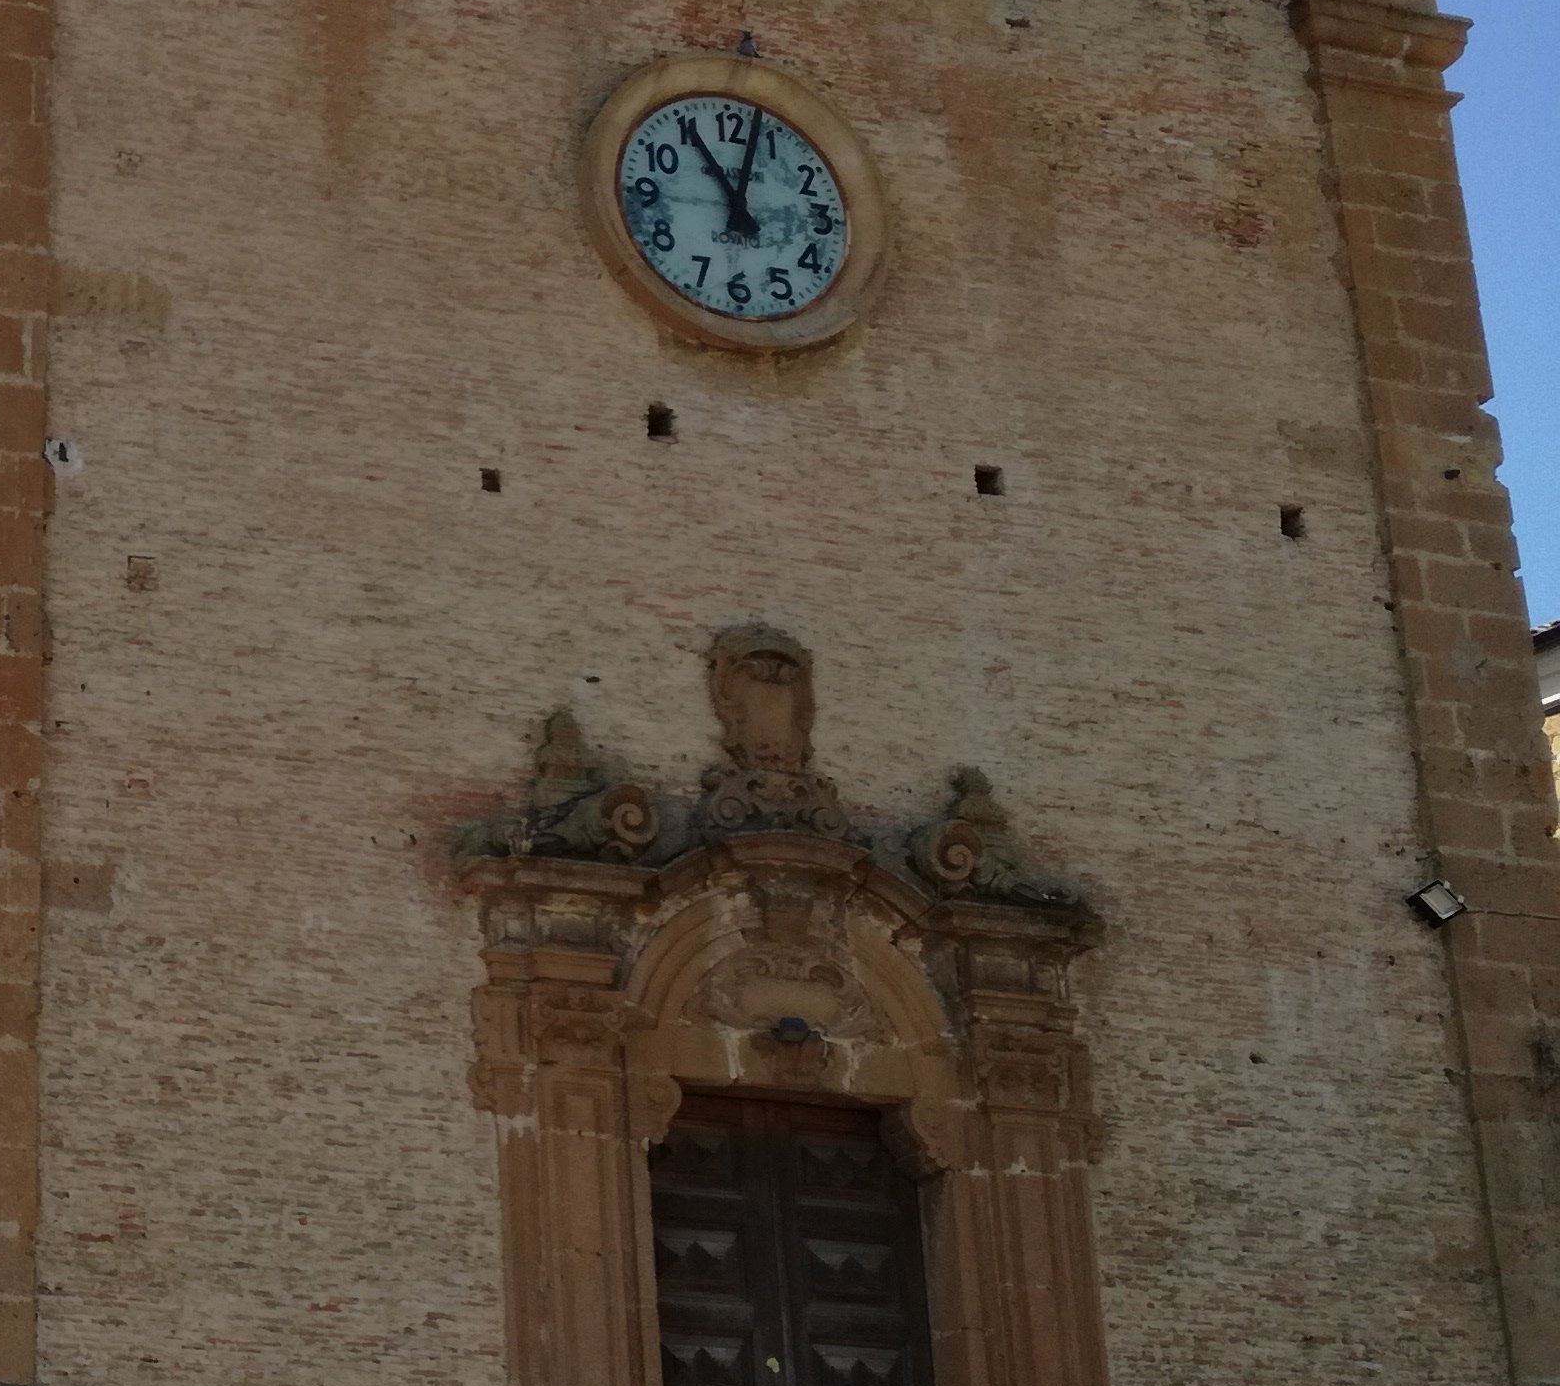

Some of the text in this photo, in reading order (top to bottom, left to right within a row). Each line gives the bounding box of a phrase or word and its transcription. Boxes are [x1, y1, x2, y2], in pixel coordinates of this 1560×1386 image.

[677, 115, 698, 147] 11
[715, 111, 747, 145] 12
[765, 129, 777, 160] 1
[645, 141, 679, 175] 10
[634, 176, 660, 209] 9
[797, 164, 818, 197] 2
[810, 202, 834, 235] 3
[652, 219, 675, 252] 8
[691, 254, 711, 288] 7
[797, 243, 822, 274] 4
[727, 271, 752, 304] 6
[768, 266, 793, 301] 5
